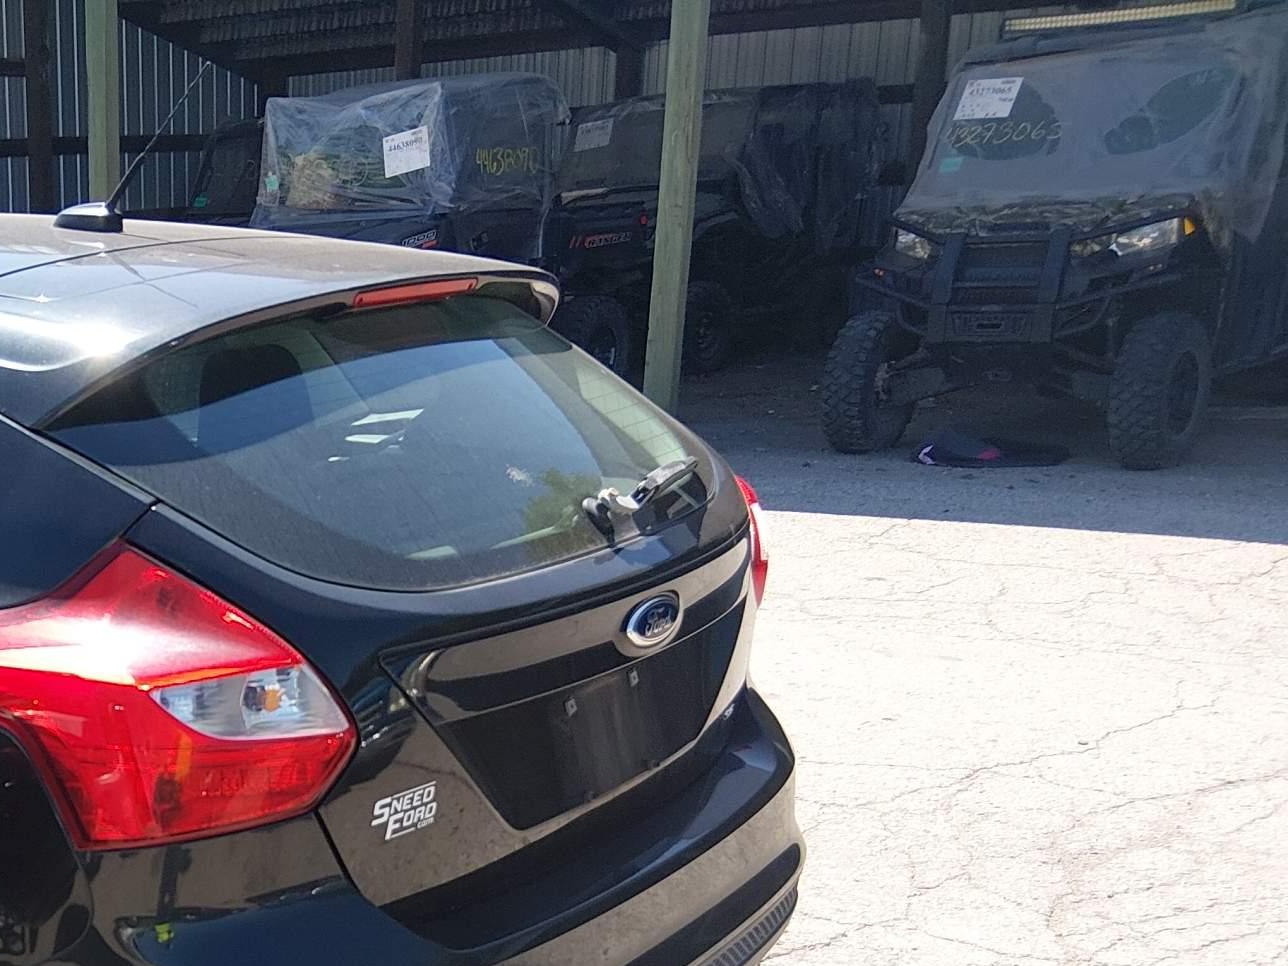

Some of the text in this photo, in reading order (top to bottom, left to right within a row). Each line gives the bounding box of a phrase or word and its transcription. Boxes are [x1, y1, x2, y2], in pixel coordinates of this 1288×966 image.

[645, 607, 672, 636] Ford
[371, 786, 436, 827] SNEED
[385, 802, 437, 840] FORD
